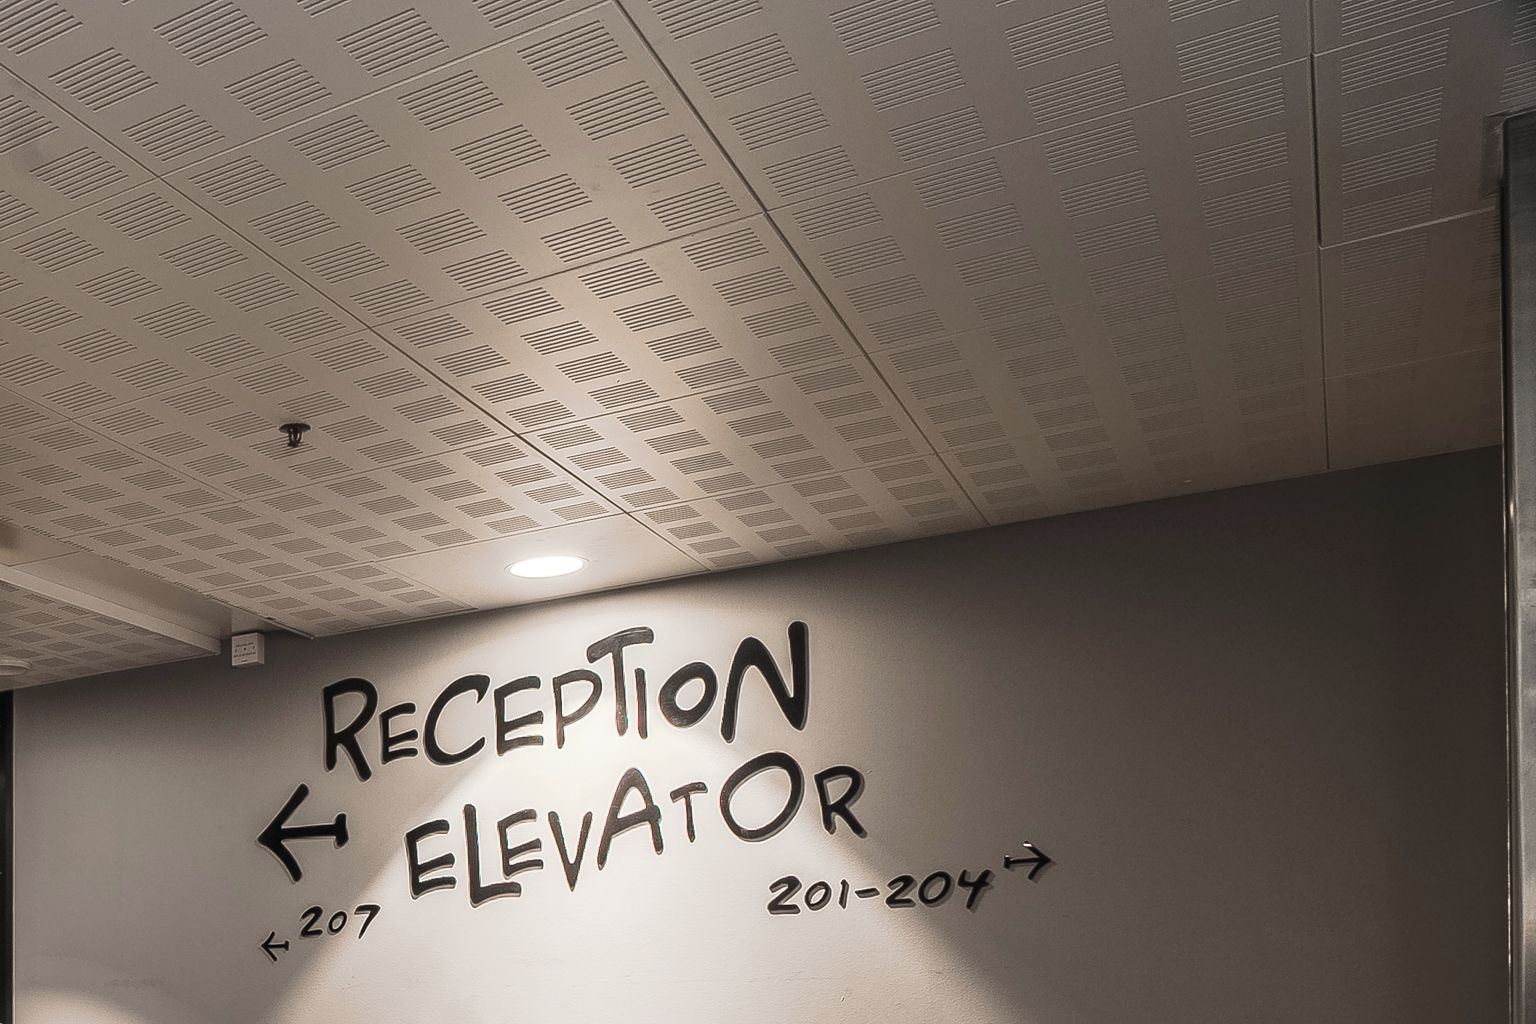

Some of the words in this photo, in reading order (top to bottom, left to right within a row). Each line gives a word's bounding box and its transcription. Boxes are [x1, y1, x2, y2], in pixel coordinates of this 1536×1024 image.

[322, 621, 810, 781] RECEPTION
[404, 751, 868, 907] ELEVATOR
[298, 904, 382, 940] 207
[766, 869, 993, 915] 201-204
